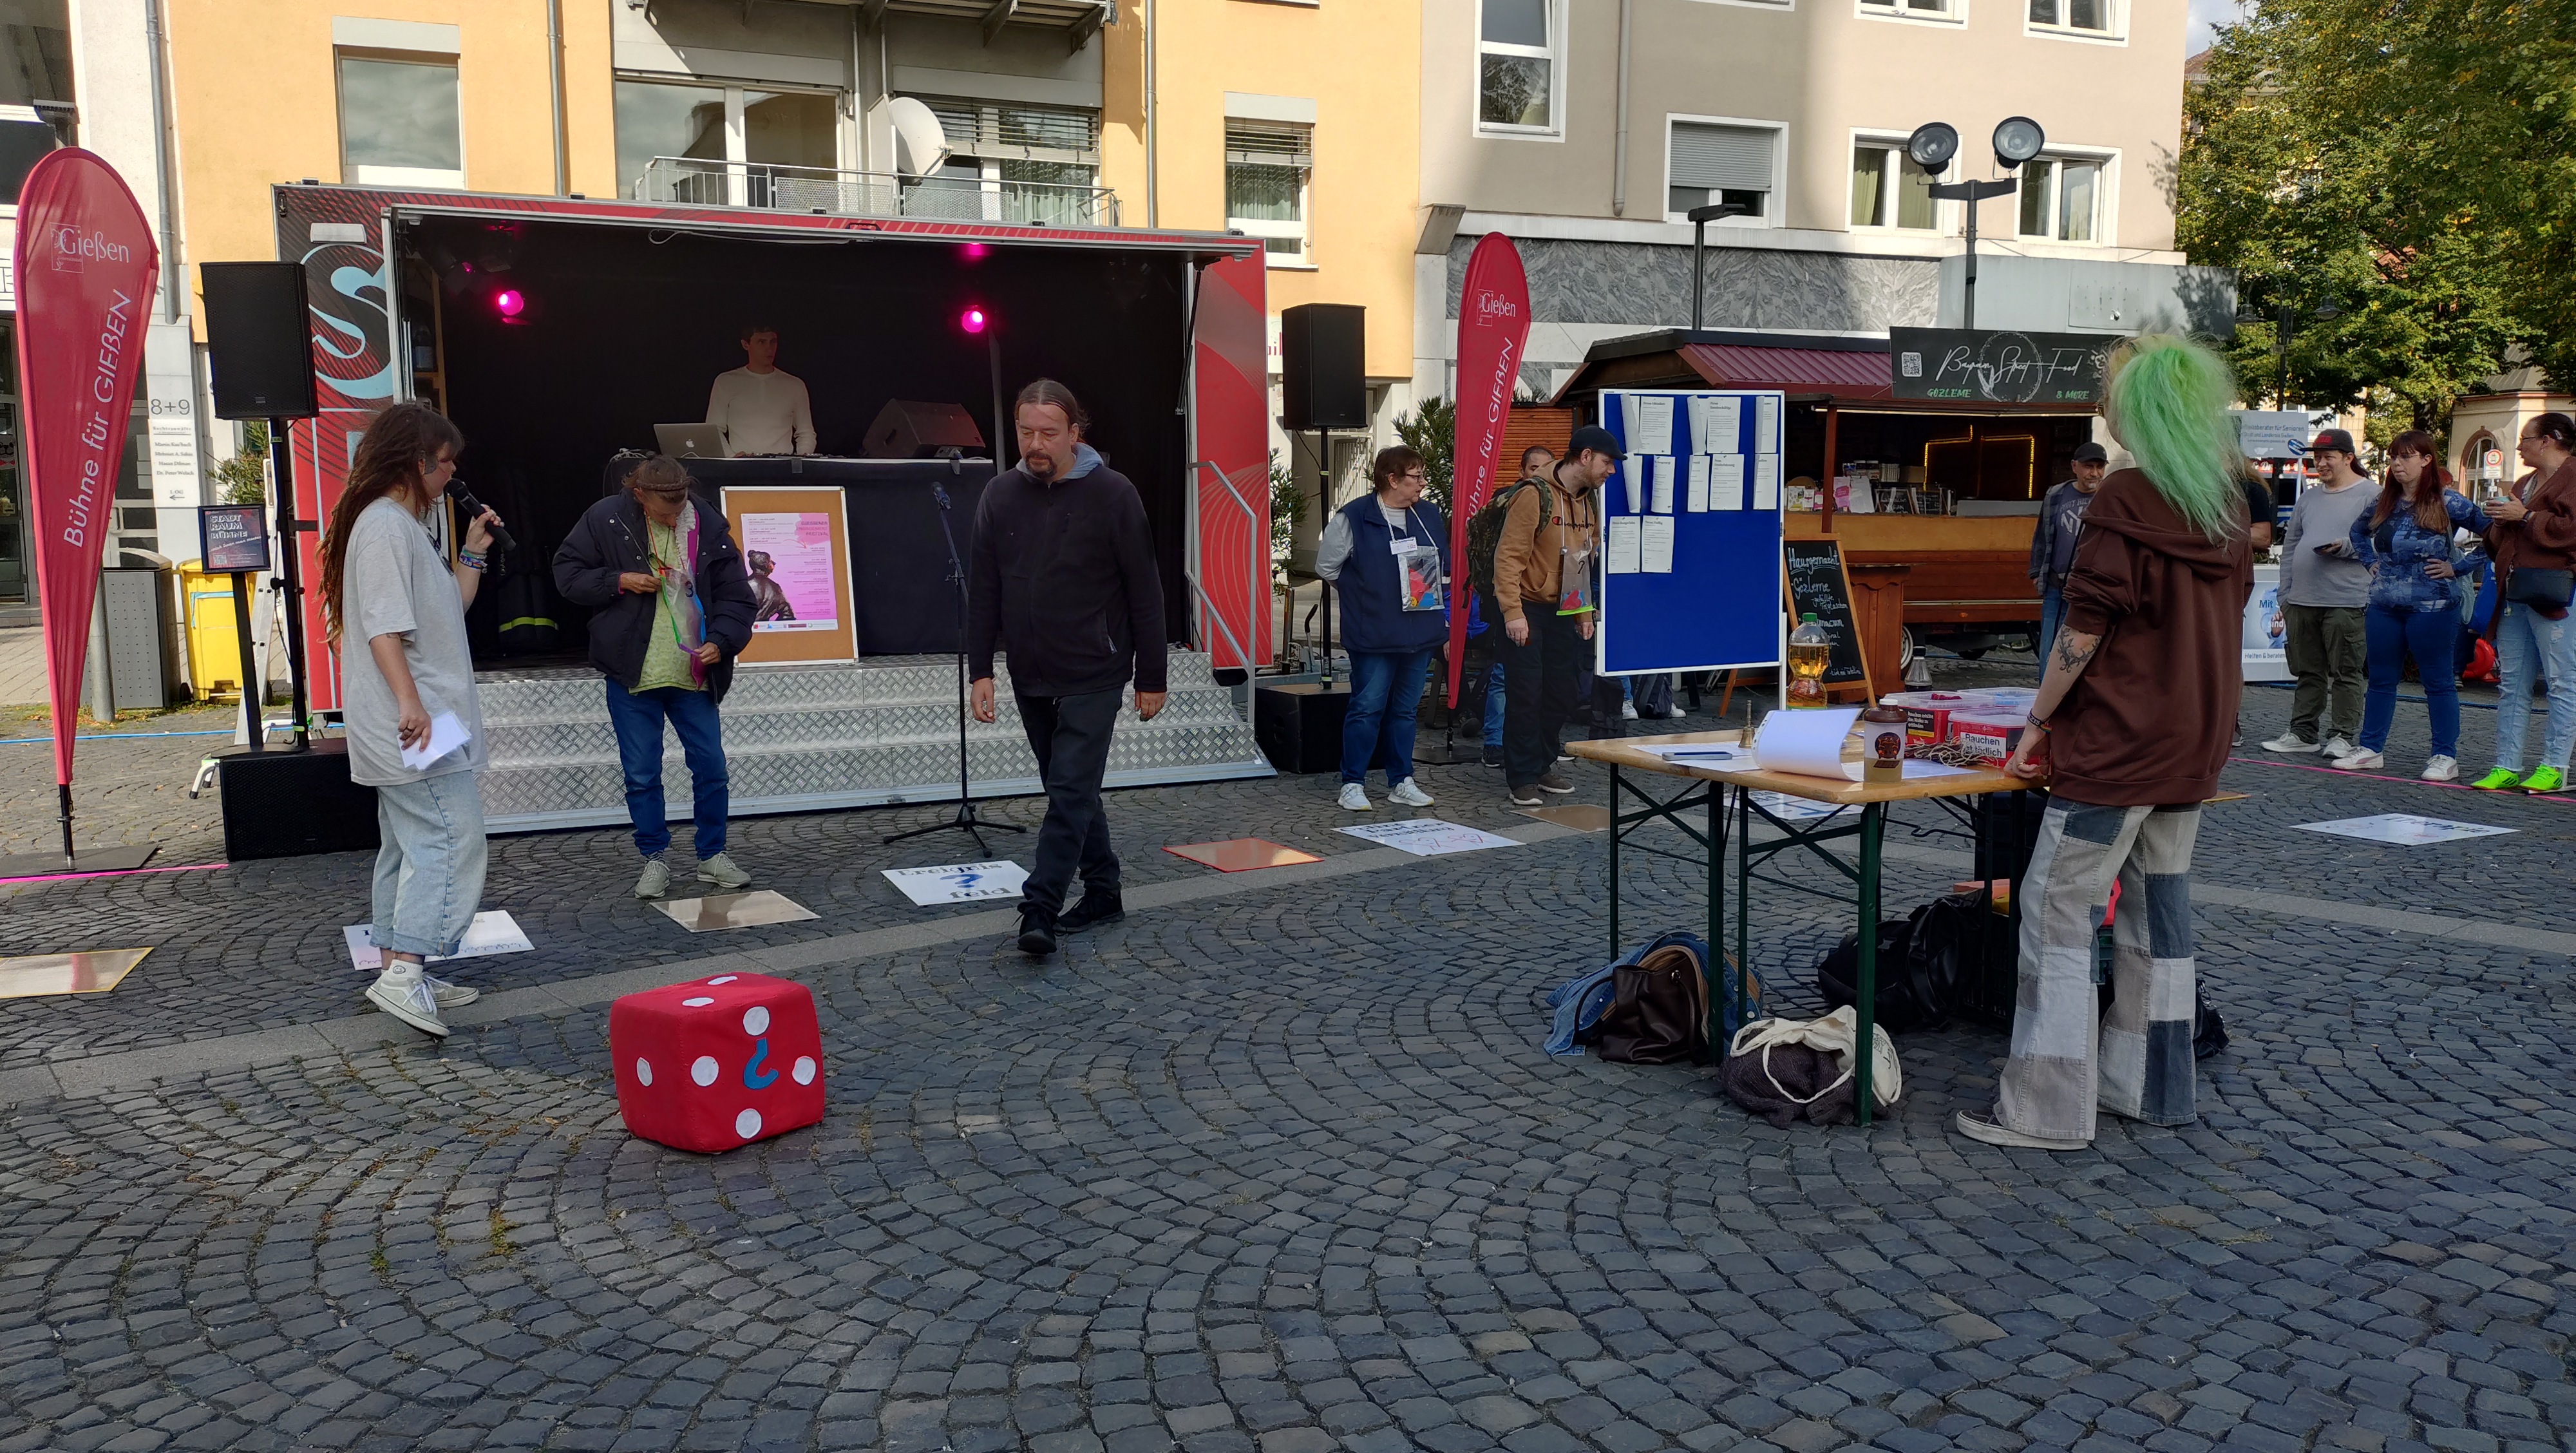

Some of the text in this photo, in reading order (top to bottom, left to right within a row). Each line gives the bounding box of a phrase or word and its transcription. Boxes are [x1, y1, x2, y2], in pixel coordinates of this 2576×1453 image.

[60, 228, 129, 263] Gießen
[1481, 292, 1516, 318] Gießen
[2046, 348, 2086, 384] Food
[1480, 429, 1493, 459] für
[1488, 337, 1513, 423] GIEßEN
[2065, 390, 2090, 400] MORE
[151, 399, 190, 415] 8+9
[63, 289, 131, 547] Bühne für GIEßEN
[1788, 546, 1840, 575] Hausgemacht
[2259, 600, 2273, 608] Mit
[2268, 618, 2284, 627] sind
[1965, 733, 2000, 746] Rauchen
[1975, 746, 2002, 757] tödlich
[895, 863, 1003, 876] Ereignis
[949, 887, 1014, 899] feld
